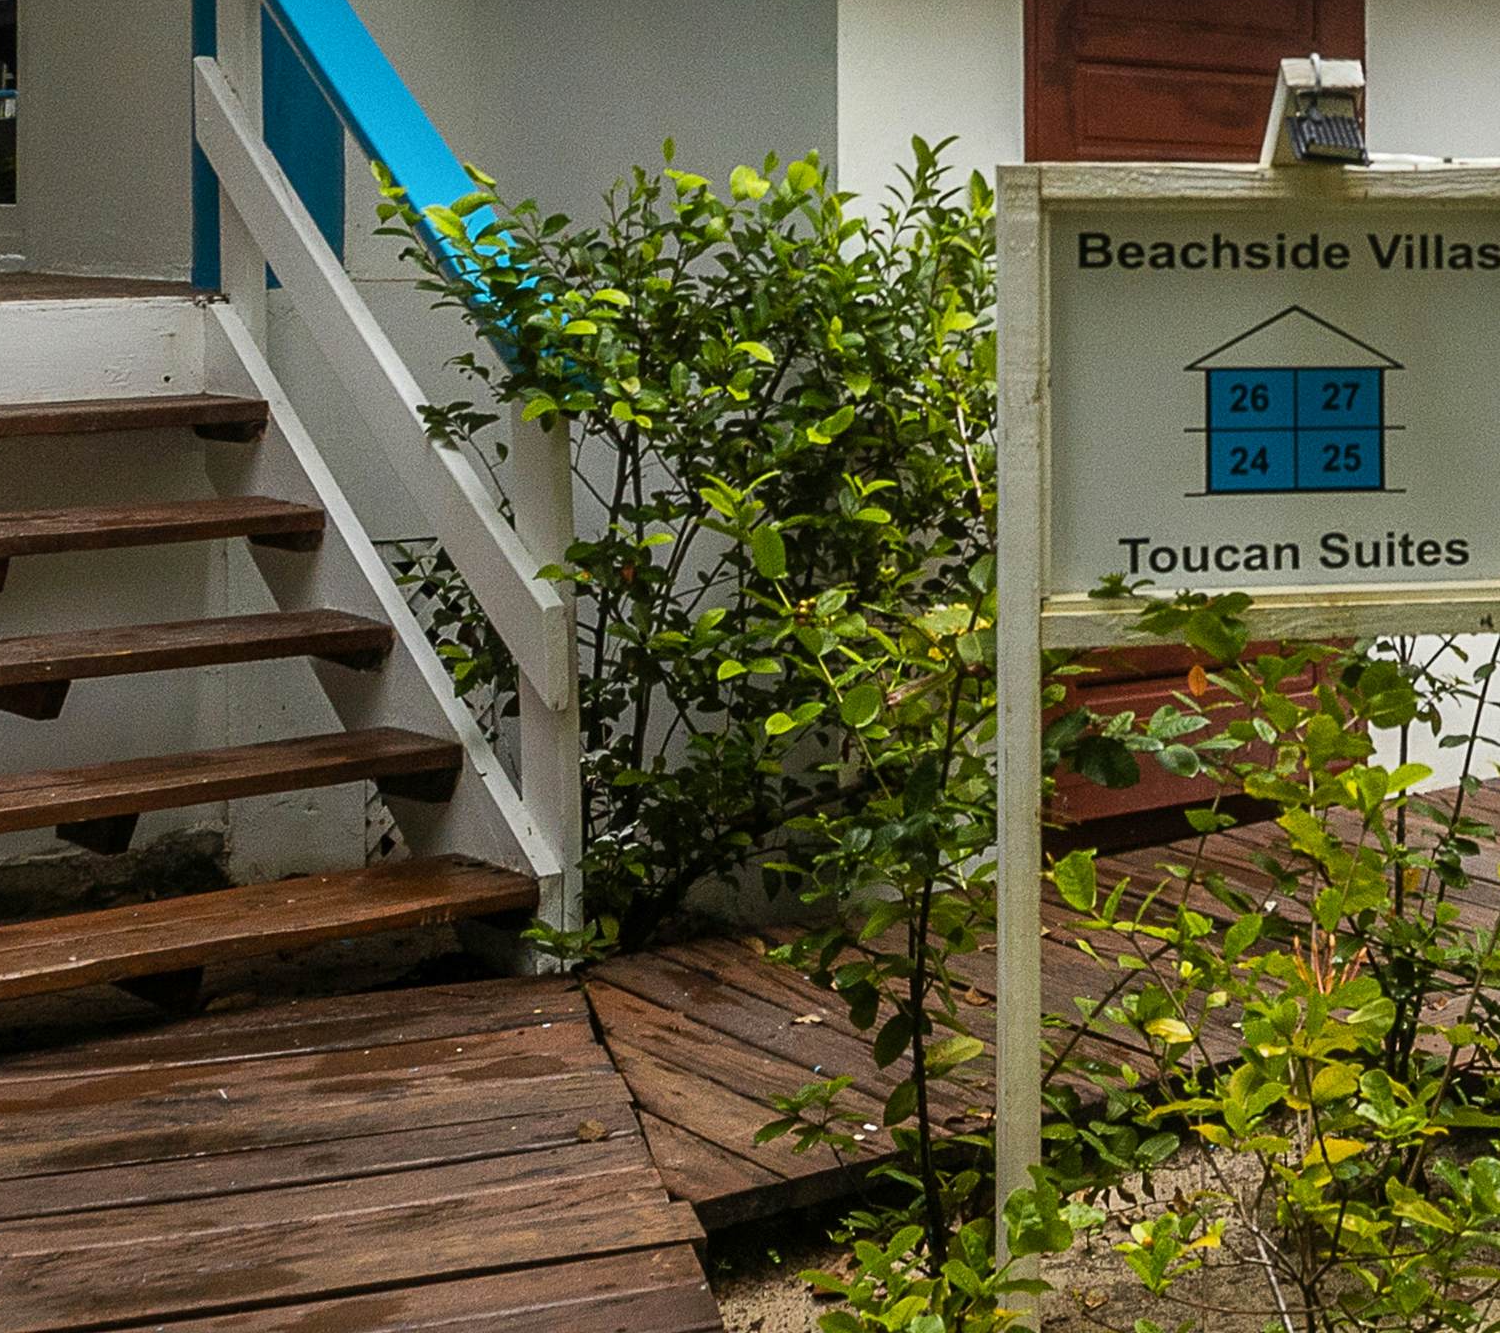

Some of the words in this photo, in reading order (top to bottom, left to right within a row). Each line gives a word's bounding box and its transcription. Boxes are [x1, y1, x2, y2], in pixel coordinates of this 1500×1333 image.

[1078, 232, 1350, 270] Beachside
[1230, 383, 1270, 413] 26
[1322, 382, 1361, 411] 27
[1230, 446, 1270, 476] 24
[1322, 443, 1362, 473] 25
[1118, 537, 1300, 575] Toucan
[1320, 532, 1470, 569] Suites
